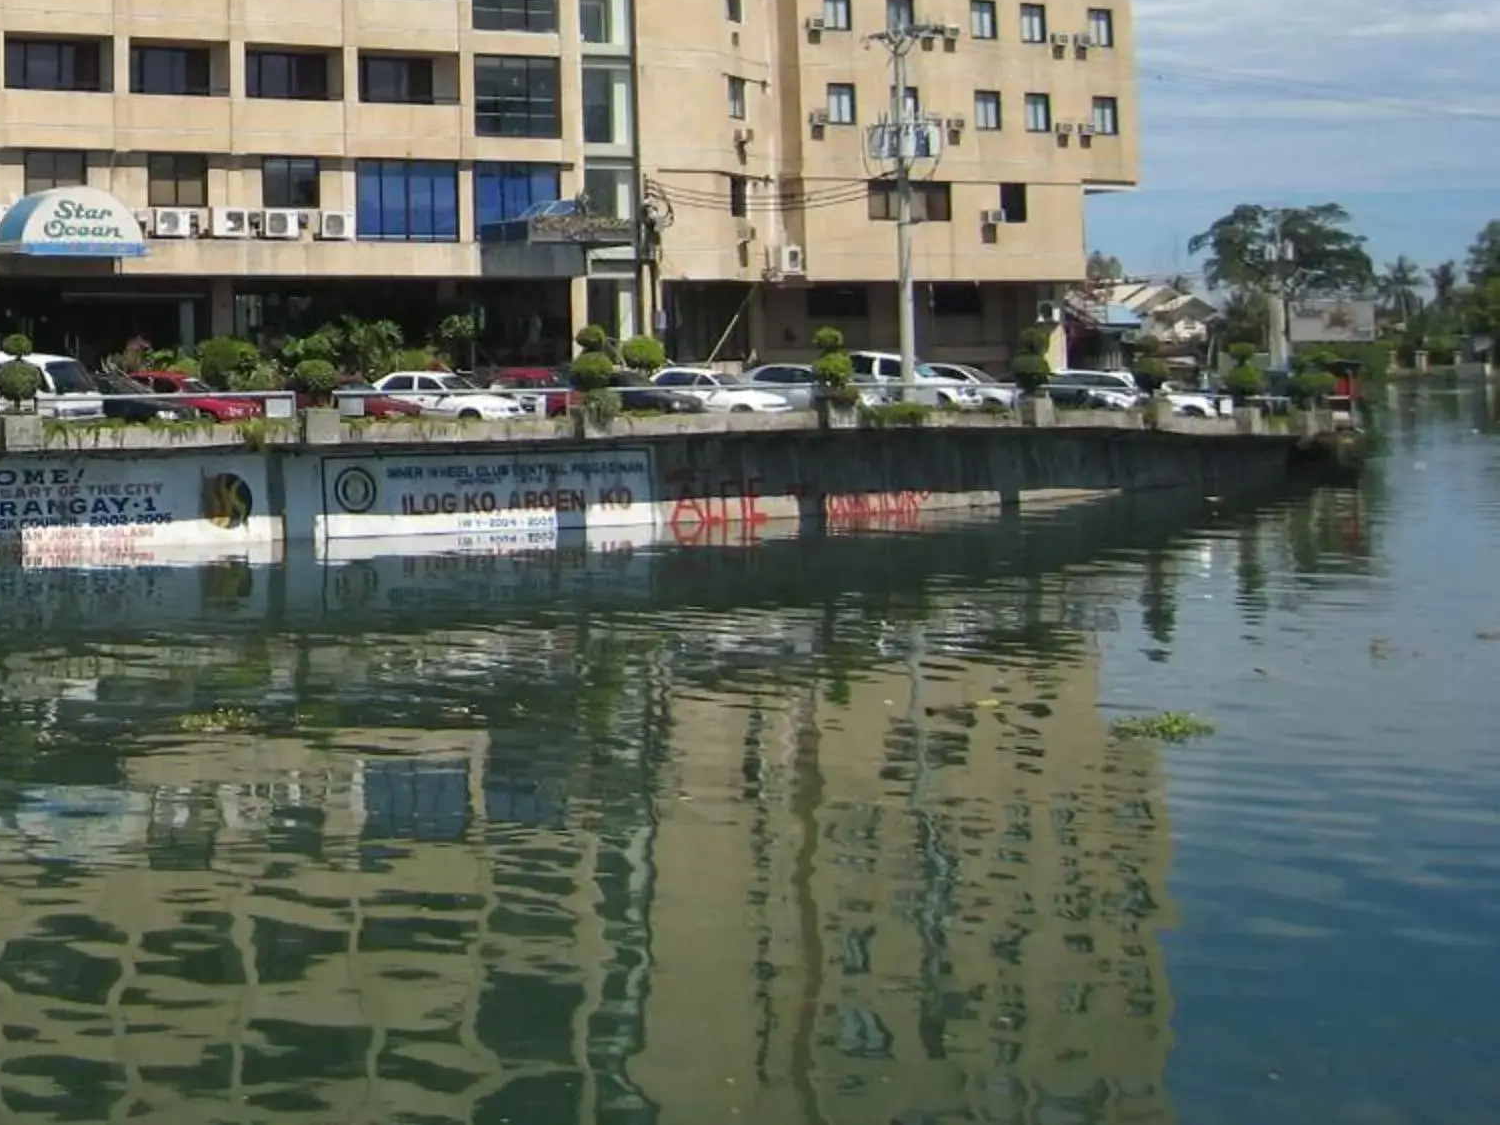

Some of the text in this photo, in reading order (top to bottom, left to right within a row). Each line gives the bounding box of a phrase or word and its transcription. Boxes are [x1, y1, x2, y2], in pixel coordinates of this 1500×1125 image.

[53, 199, 113, 220] Star
[43, 219, 123, 238] Ocean
[59, 483, 80, 497] OF
[122, 482, 164, 496] CITY
[401, 492, 457, 515] ILOG
[599, 486, 634, 512] KO
